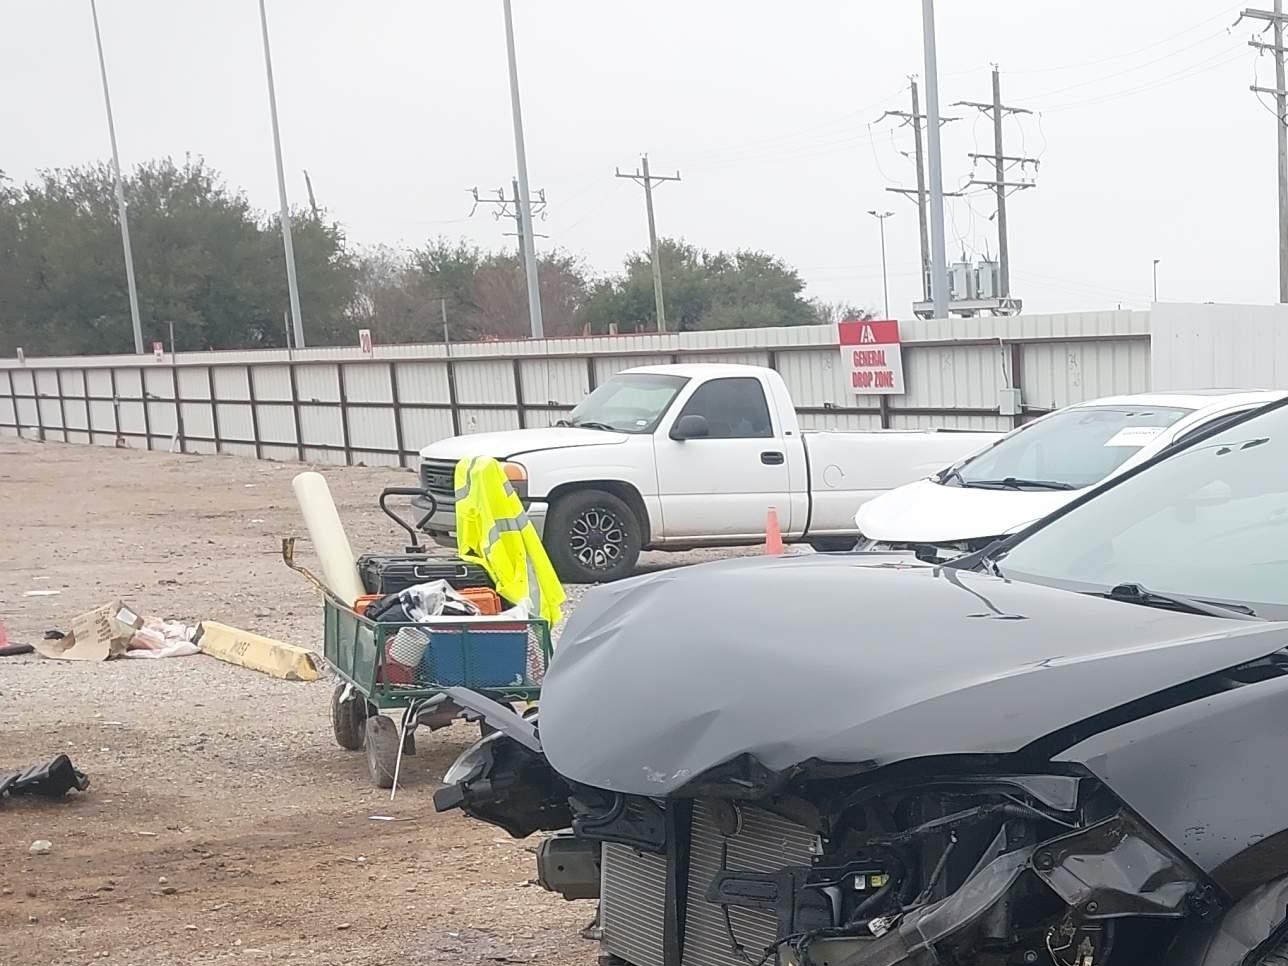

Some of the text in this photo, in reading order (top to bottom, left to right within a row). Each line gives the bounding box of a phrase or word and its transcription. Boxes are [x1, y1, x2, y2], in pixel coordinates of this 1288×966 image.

[853, 350, 886, 366] GENERAL
[852, 371, 894, 388] DROP ZONE
